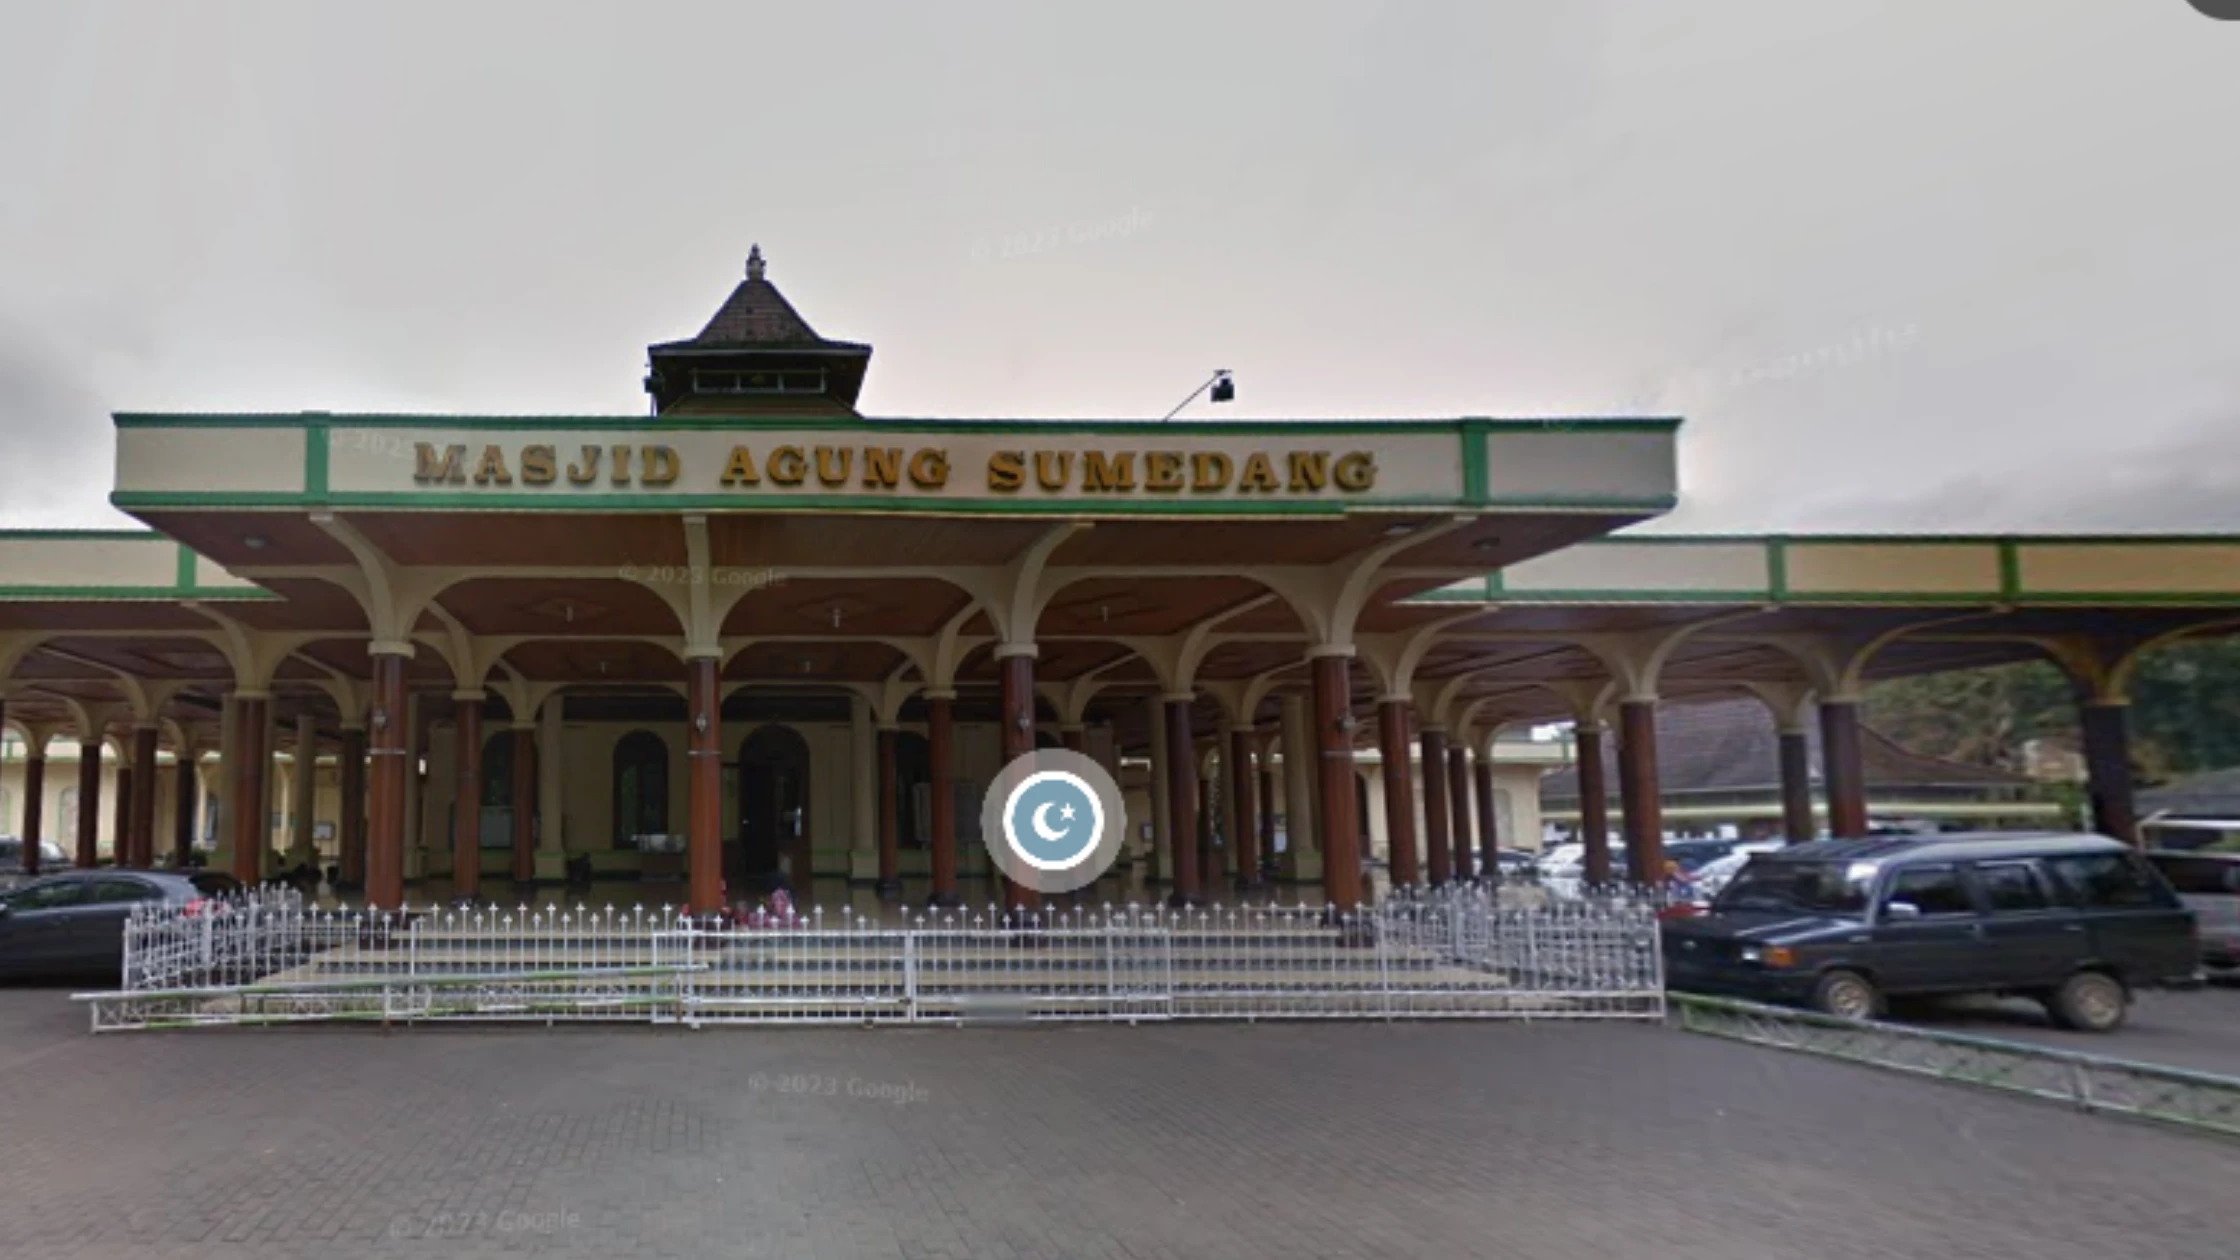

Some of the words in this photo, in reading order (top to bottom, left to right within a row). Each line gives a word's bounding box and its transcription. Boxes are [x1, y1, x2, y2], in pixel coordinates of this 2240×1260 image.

[412, 441, 682, 487] MASJID
[719, 443, 951, 490] AGUNG
[987, 449, 1378, 494] SUMEDANG
